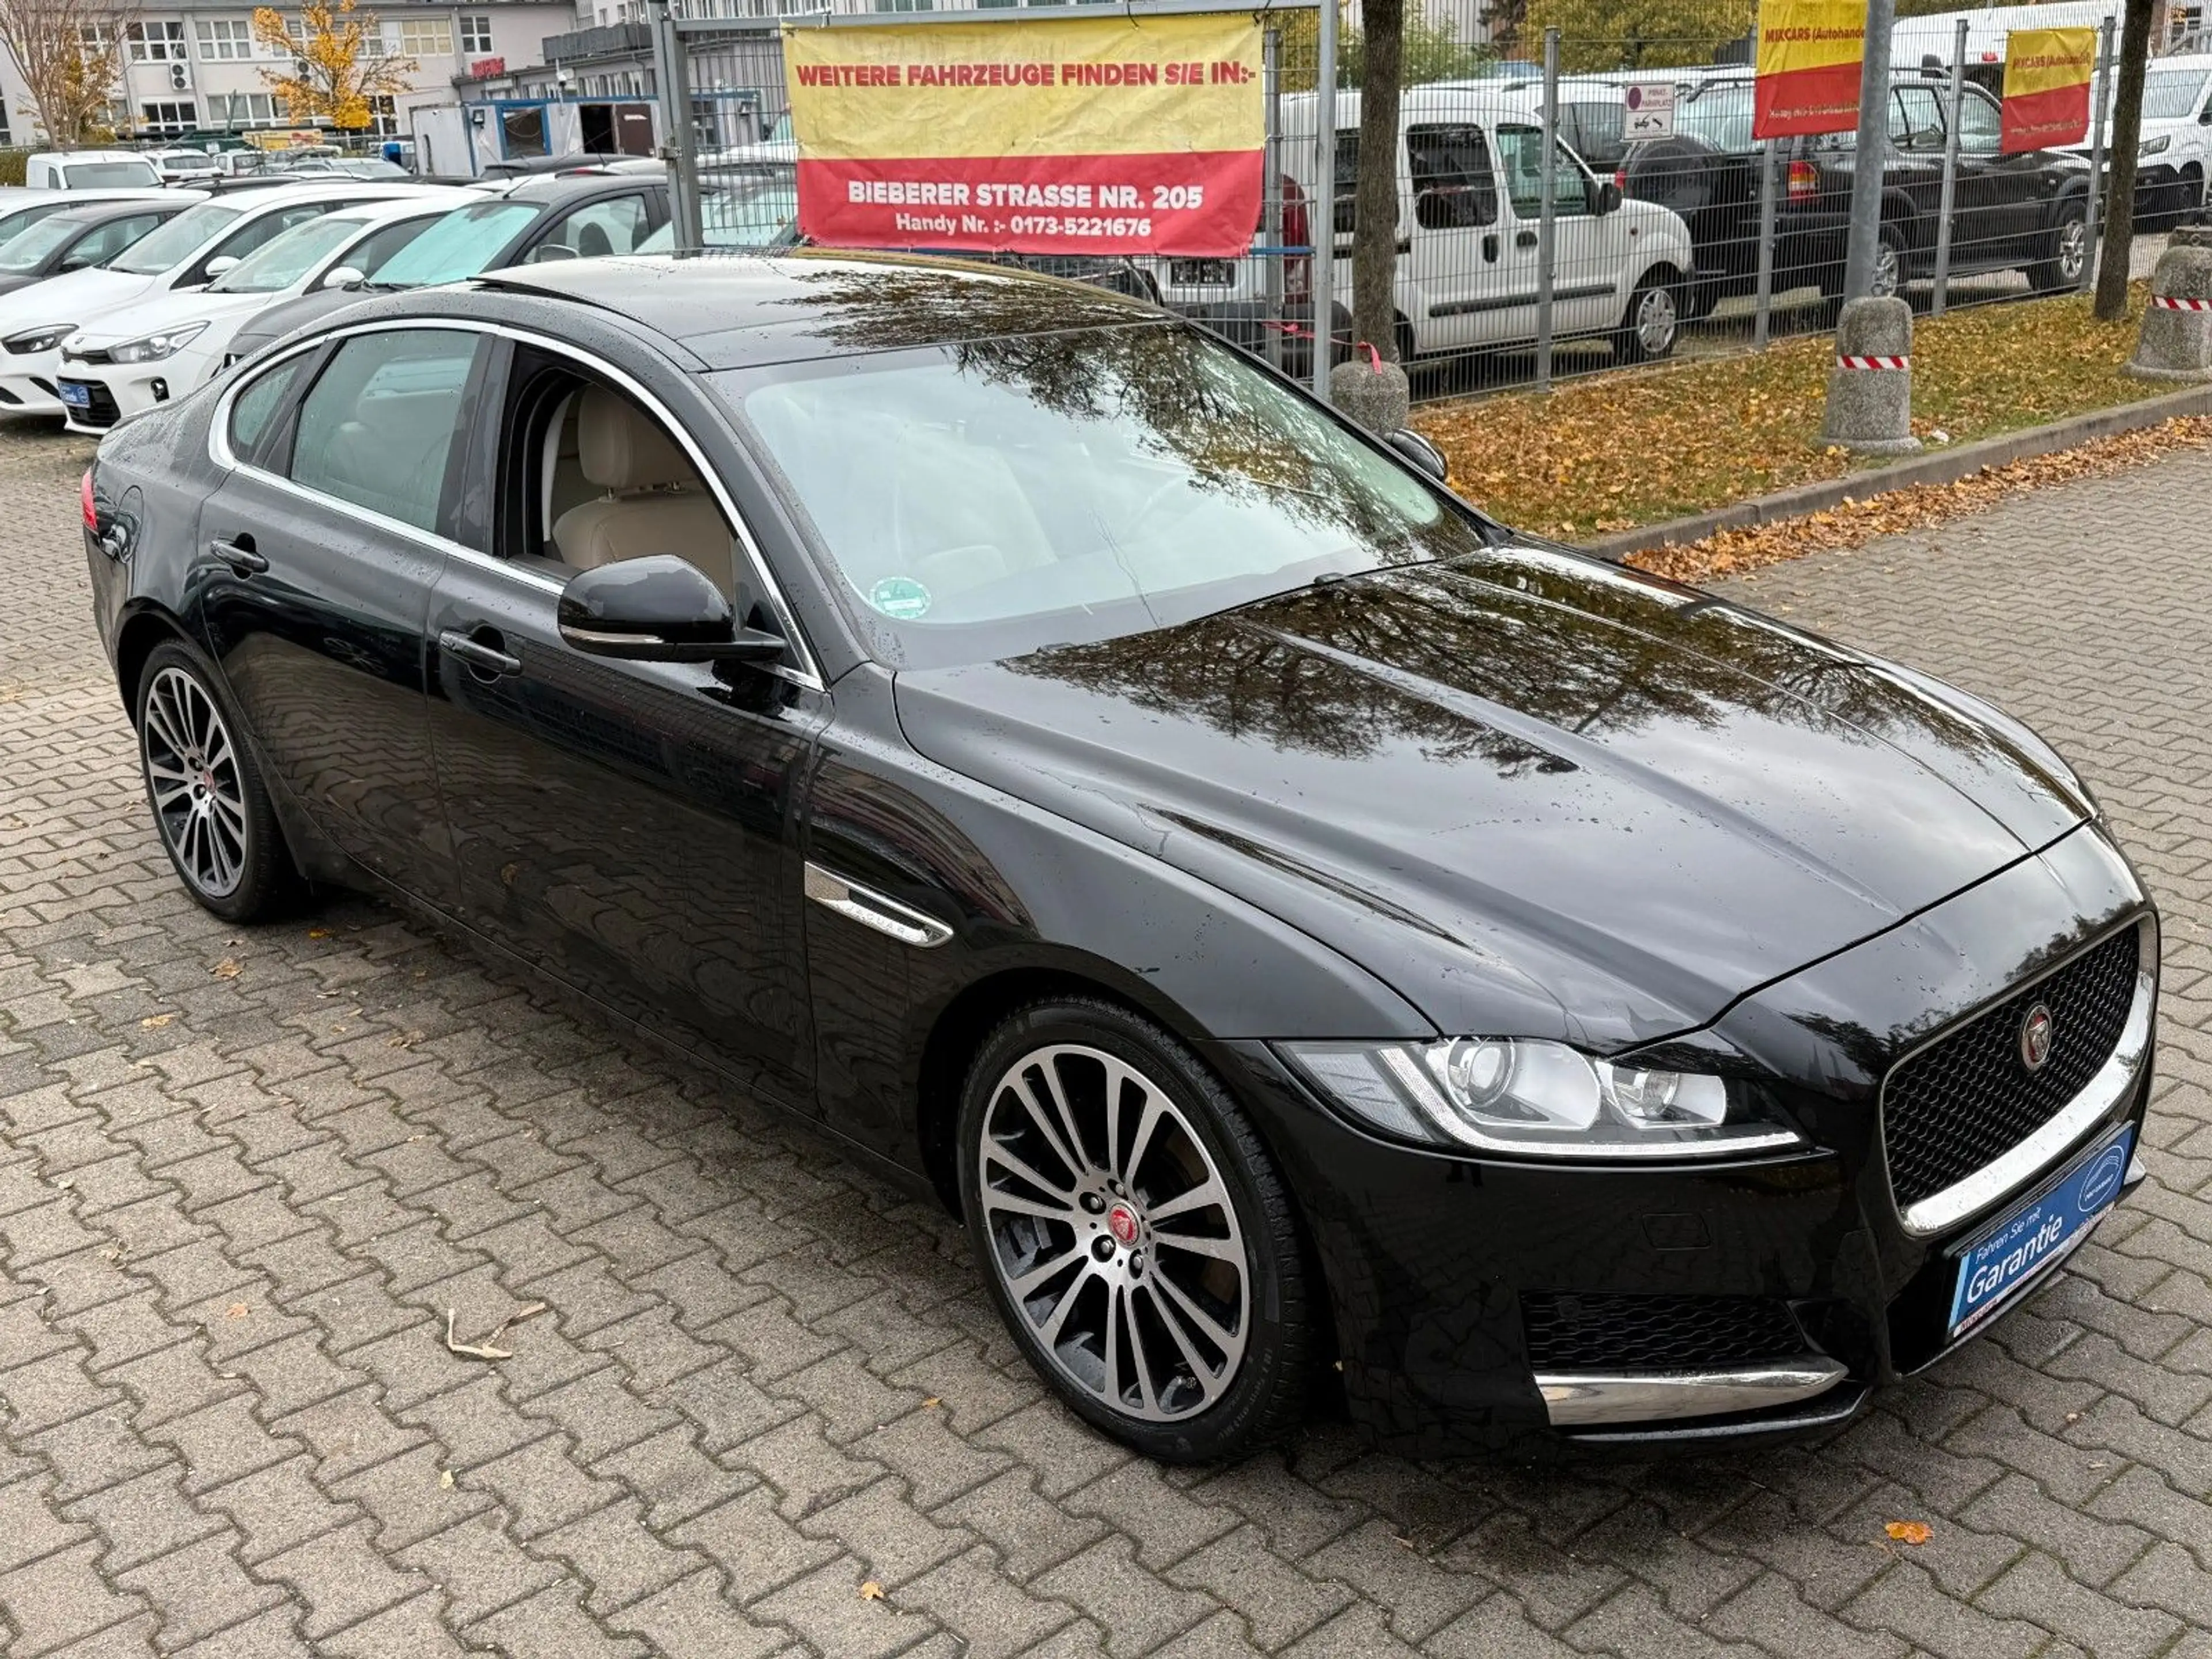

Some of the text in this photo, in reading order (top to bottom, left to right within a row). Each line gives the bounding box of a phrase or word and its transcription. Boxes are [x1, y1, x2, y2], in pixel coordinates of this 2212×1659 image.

[1765, 28, 1812, 43] MIXCARS
[796, 64, 902, 87] WEITERE
[907, 63, 1055, 86] FAHRZEUGE
[1061, 63, 1158, 86] FINDEN
[1165, 63, 1204, 85] SIE
[848, 181, 1203, 210] BIEBERER STRASSE NR. 205
[895, 213, 957, 236] Handy
[961, 215, 989, 234] Nr.
[1010, 215, 1152, 237] 0173-5221676
[1975, 1207, 2041, 1264] Fahren Sie mit
[1967, 1214, 2063, 1303] Garantie
